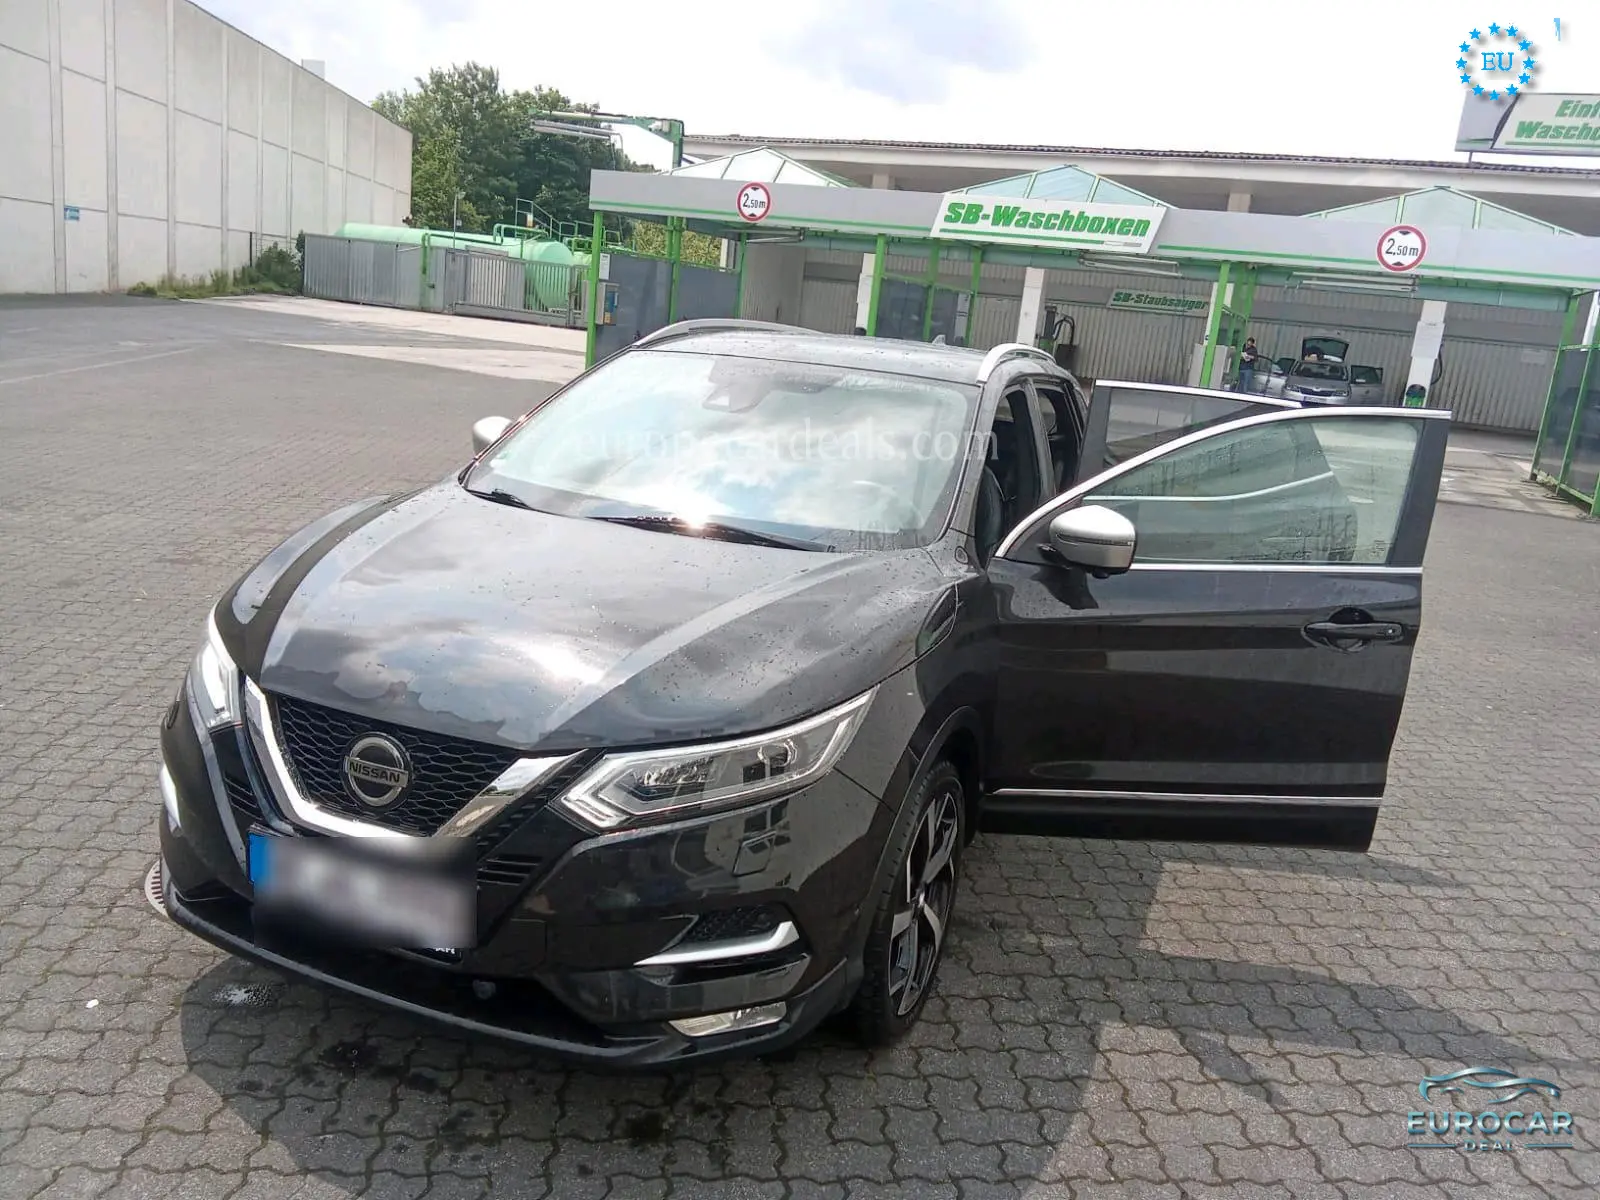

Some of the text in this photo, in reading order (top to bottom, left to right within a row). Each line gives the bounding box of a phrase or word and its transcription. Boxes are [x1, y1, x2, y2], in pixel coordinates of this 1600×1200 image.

[943, 202, 1151, 237] SB-Waschboxen
[1112, 291, 1209, 310] SB-Staubsauger
[349, 760, 400, 783] NISSAN
